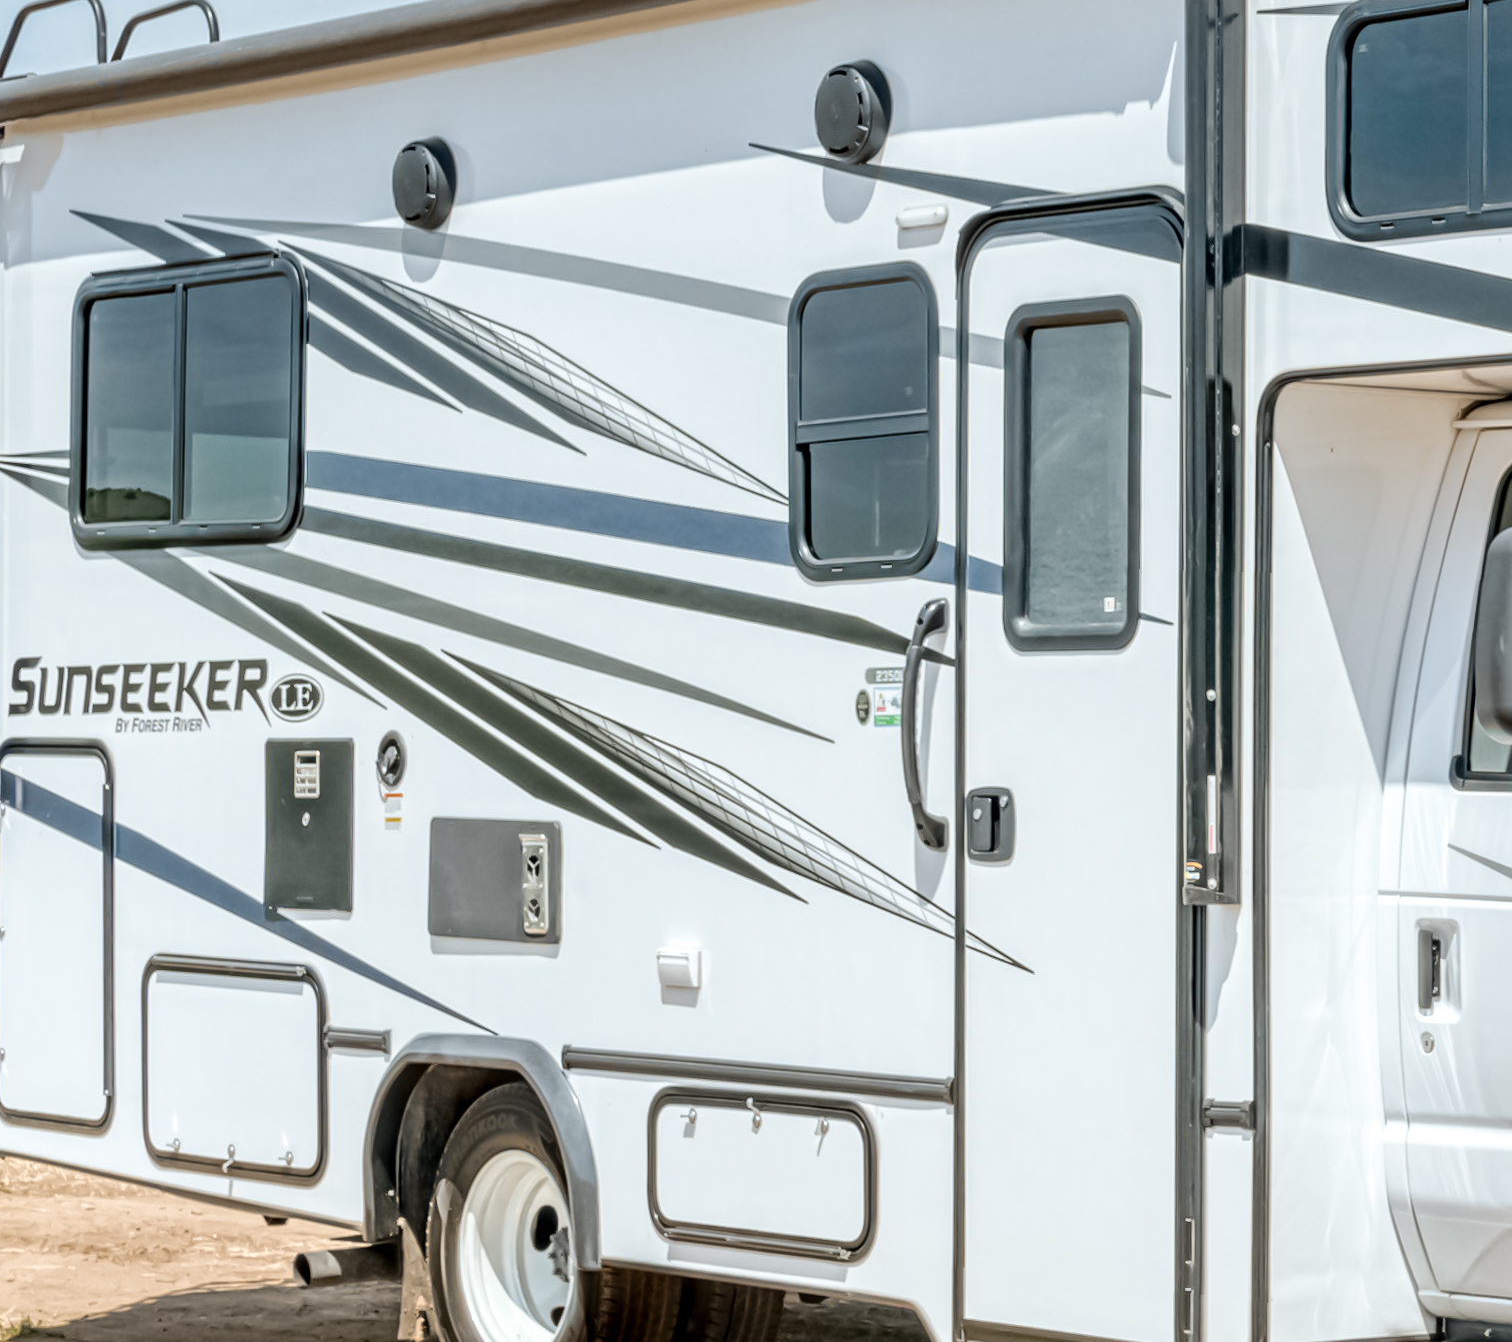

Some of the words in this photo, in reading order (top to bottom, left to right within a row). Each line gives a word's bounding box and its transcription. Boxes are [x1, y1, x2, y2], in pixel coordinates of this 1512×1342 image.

[8, 656, 272, 727] SUNSEEKER
[278, 683, 315, 712] LE
[132, 717, 169, 733] FOREST
[172, 717, 203, 732] RIVER
